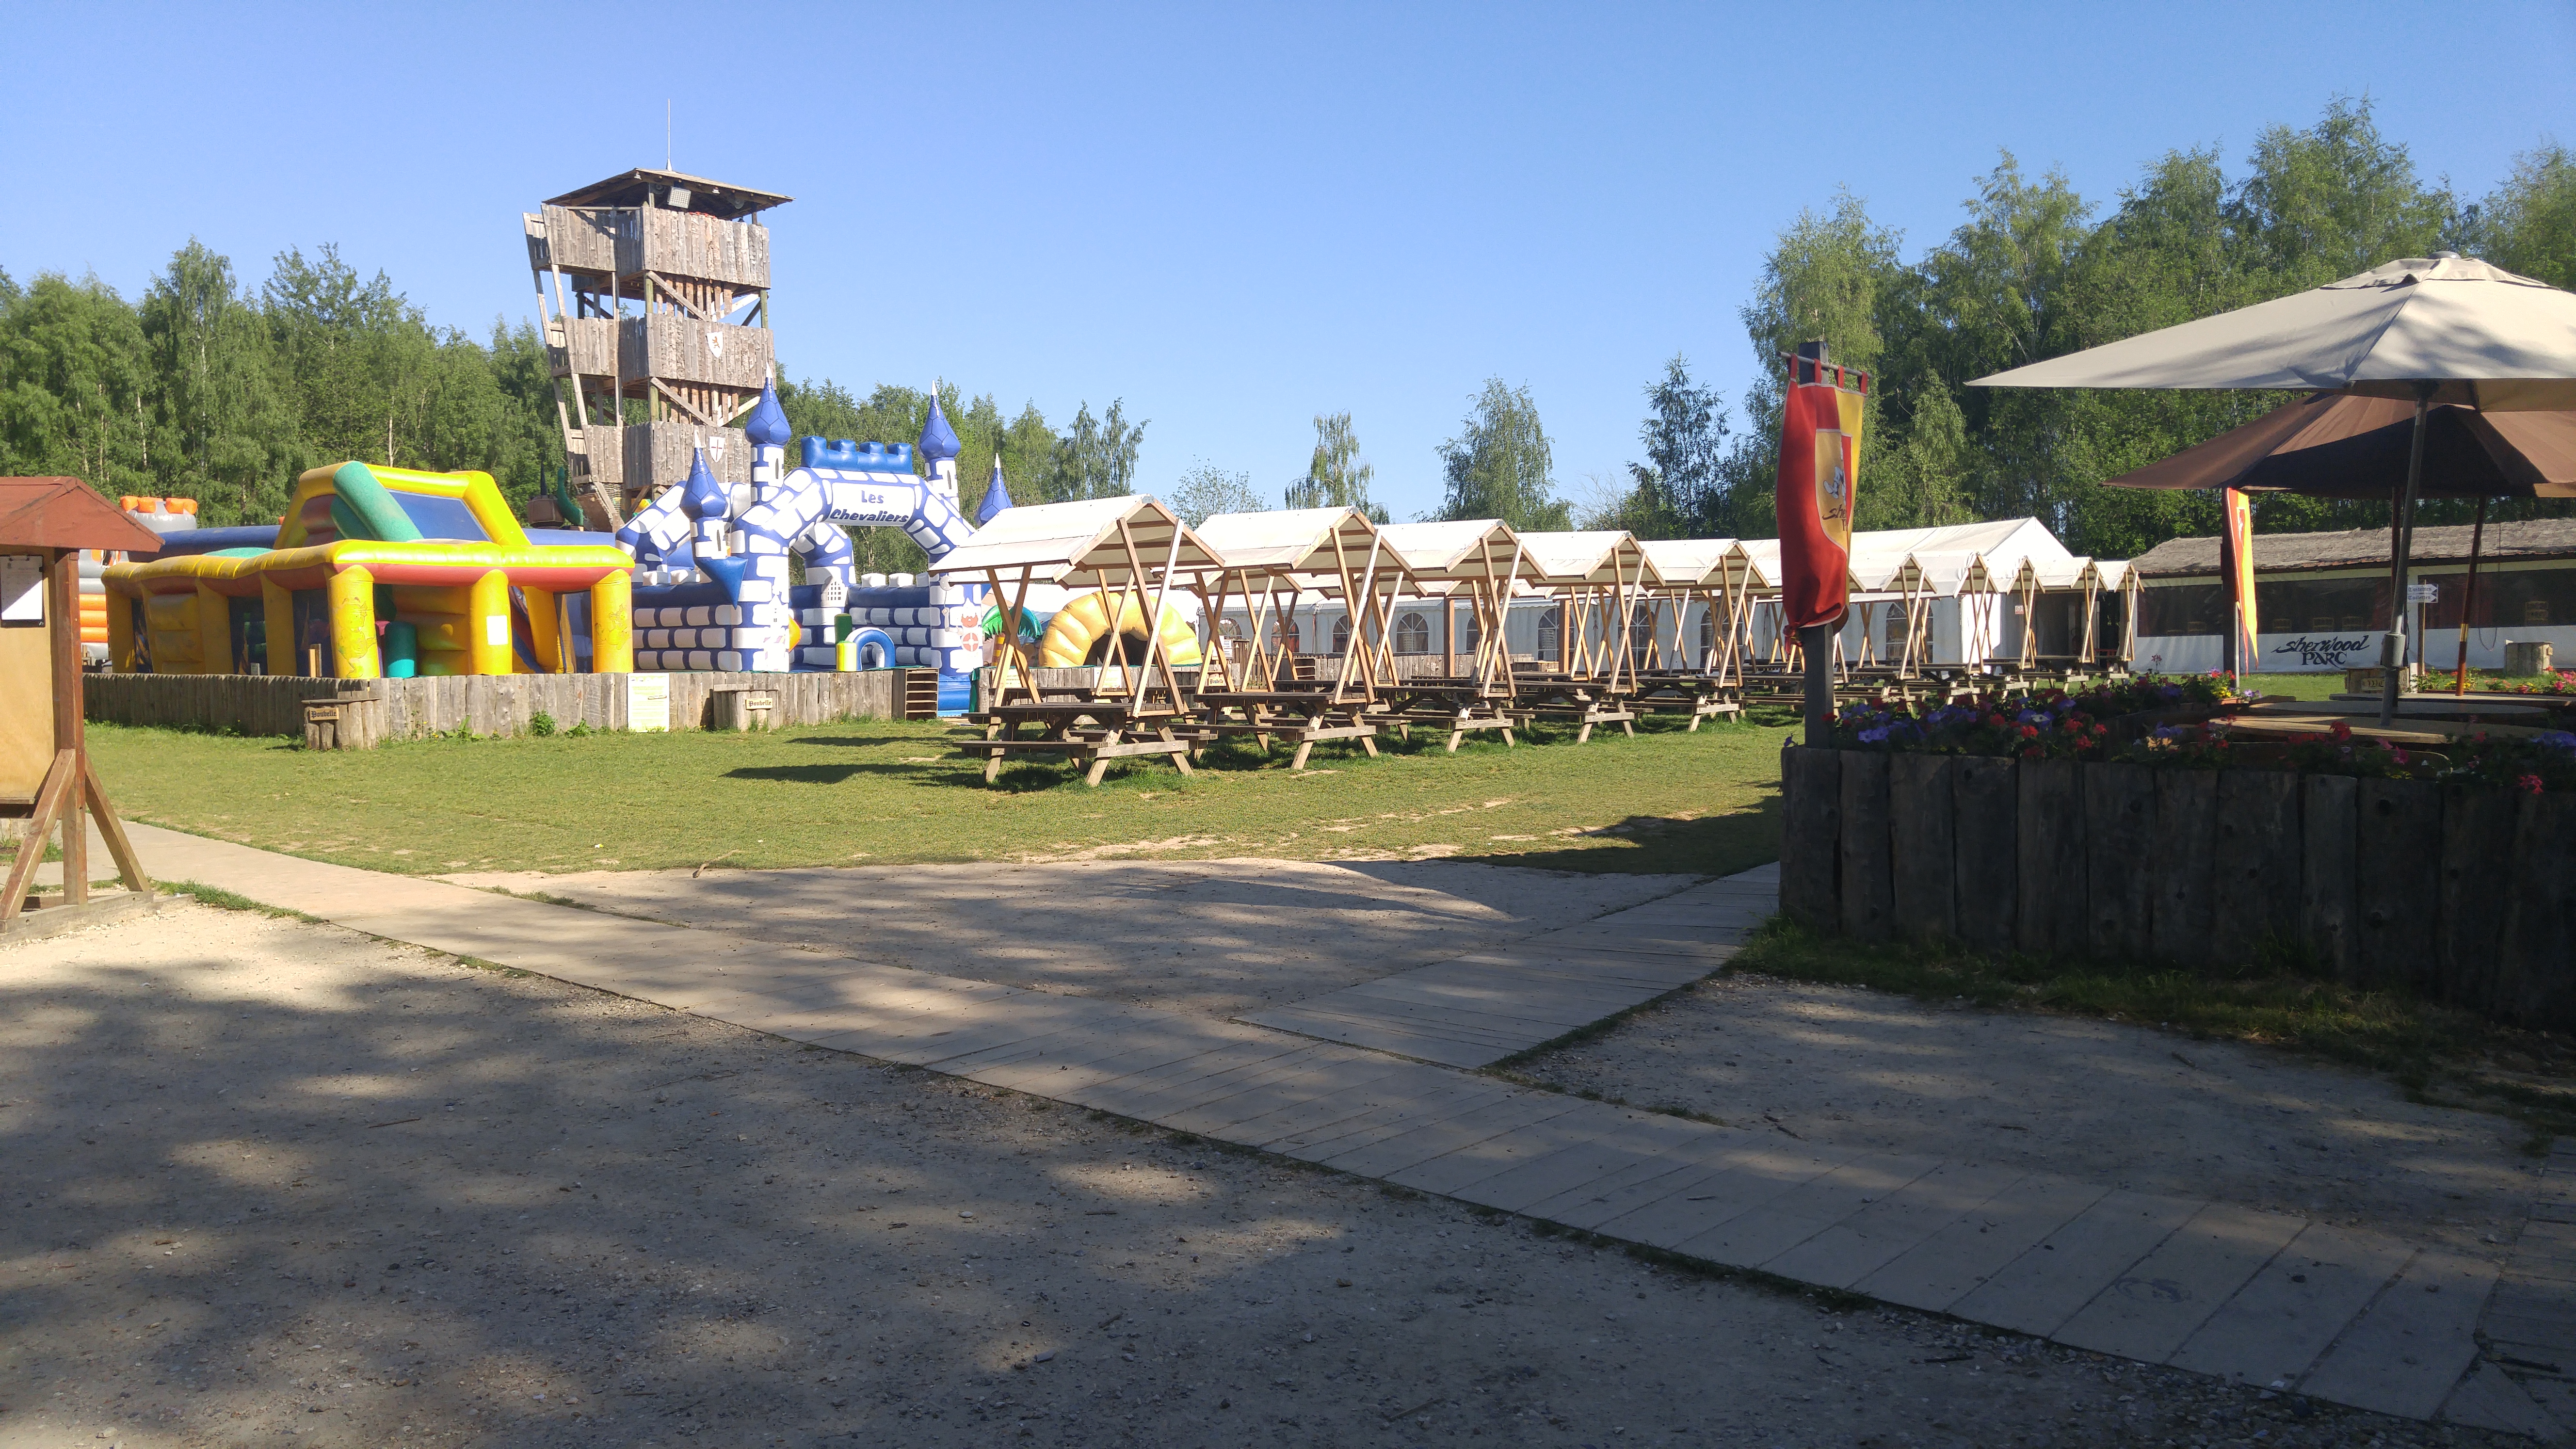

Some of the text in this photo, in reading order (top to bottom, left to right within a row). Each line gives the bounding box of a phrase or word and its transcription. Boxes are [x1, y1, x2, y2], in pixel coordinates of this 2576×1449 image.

[861, 490, 884, 504] Les
[830, 509, 909, 522] Chevaliers
[311, 710, 337, 719] Poubelle
